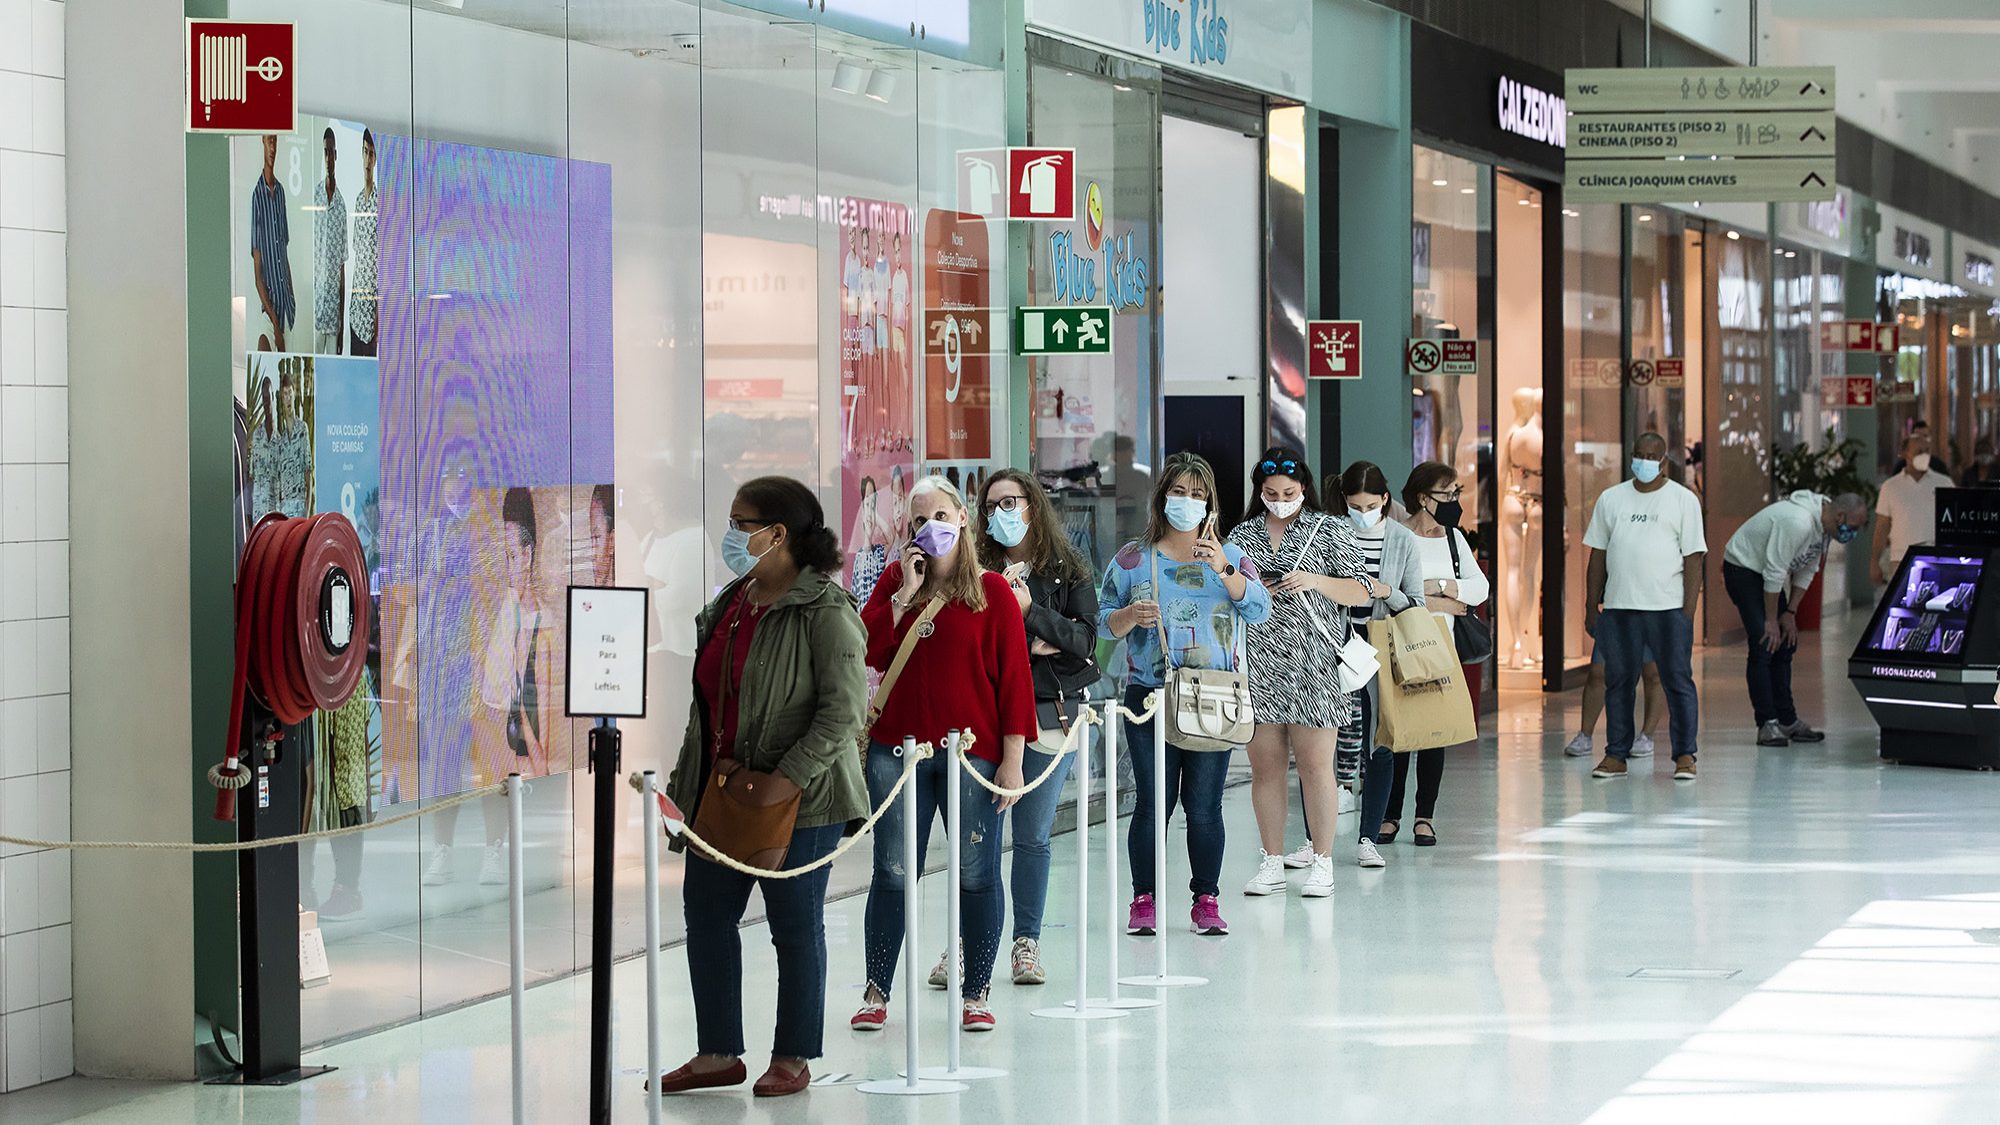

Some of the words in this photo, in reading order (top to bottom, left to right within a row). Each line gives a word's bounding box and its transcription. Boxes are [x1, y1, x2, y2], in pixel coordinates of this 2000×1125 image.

[1144, 0, 1180, 53] Blue
[1190, 0, 1227, 66] Kids
[1578, 85, 1599, 95] WC
[1578, 123, 1676, 133] RESTAURANTES
[1678, 122, 1712, 134] (PISO
[1715, 122, 1727, 134] 2)
[1578, 137, 1628, 147] CINEMA
[1630, 137, 1663, 148] (PISO
[1666, 137, 1678, 148] 2)
[1578, 174, 1628, 187] CLÍNICA
[1629, 176, 1685, 188] JOAQUIM
[1688, 175, 1737, 186] CHAVES
[1050, 229, 1096, 306] Blue
[1102, 229, 1147, 315] Kids
[1447, 343, 1464, 352] Não
[1466, 343, 1473, 351] é
[944, 318, 962, 403] 9
[1448, 352, 1471, 360] saída
[844, 385, 859, 452] 7
[327, 424, 342, 436] NOVA
[343, 422, 368, 439] COLEÇÃO
[332, 441, 339, 452] DE
[340, 441, 364, 452] CAMISAS
[601, 634, 615, 643] Fila
[1404, 639, 1438, 653] Bershka
[599, 651, 617, 659] Para
[1872, 666, 1937, 679] PERSONALIZACIÓN
[594, 682, 621, 691] Lefties
